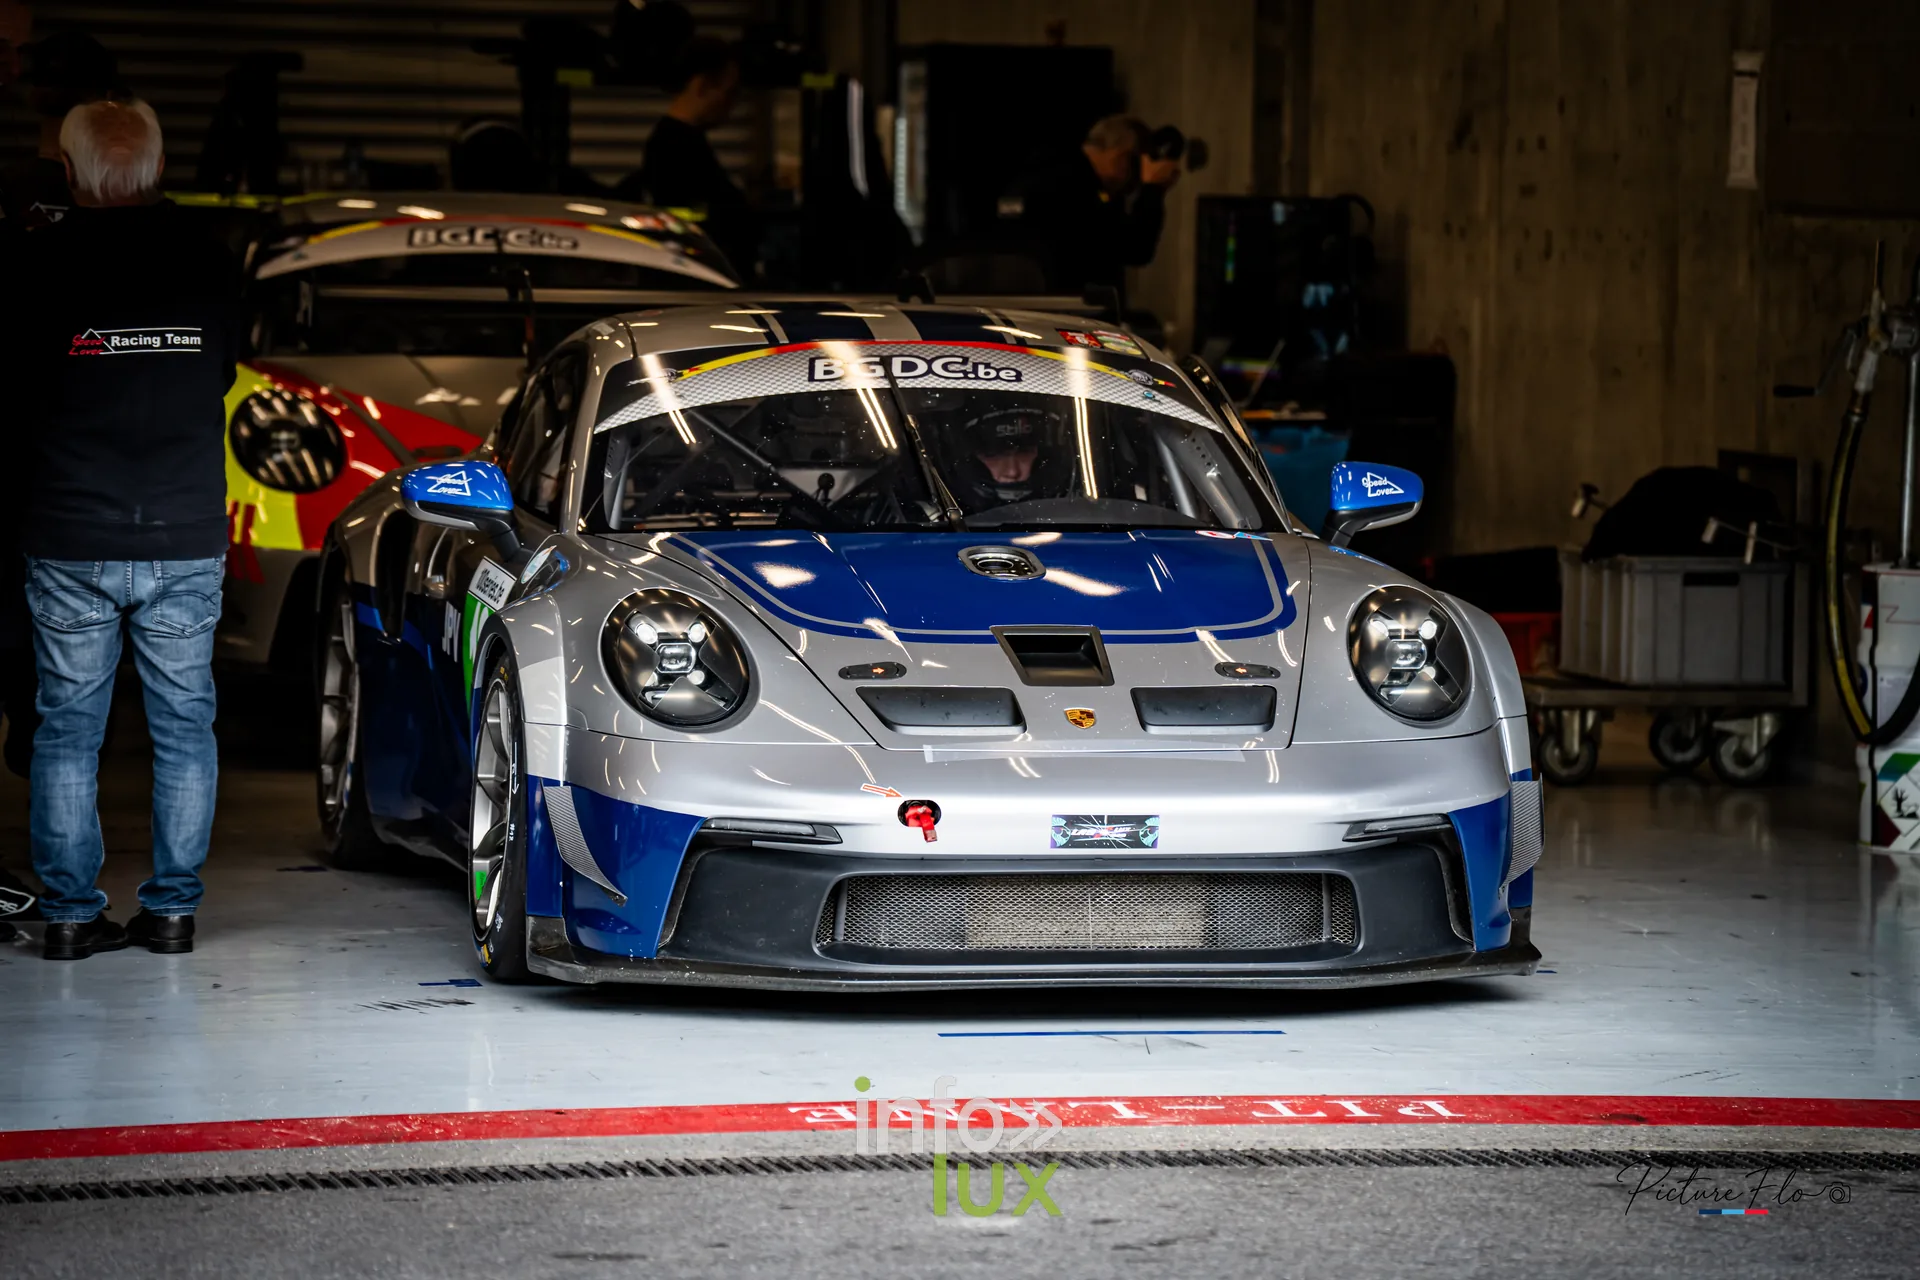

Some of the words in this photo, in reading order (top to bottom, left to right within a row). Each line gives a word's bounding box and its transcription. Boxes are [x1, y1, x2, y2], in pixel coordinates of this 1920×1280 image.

[110, 334, 161, 347] Racing
[165, 333, 201, 345] Team
[811, 355, 1021, 381] BGDC.be
